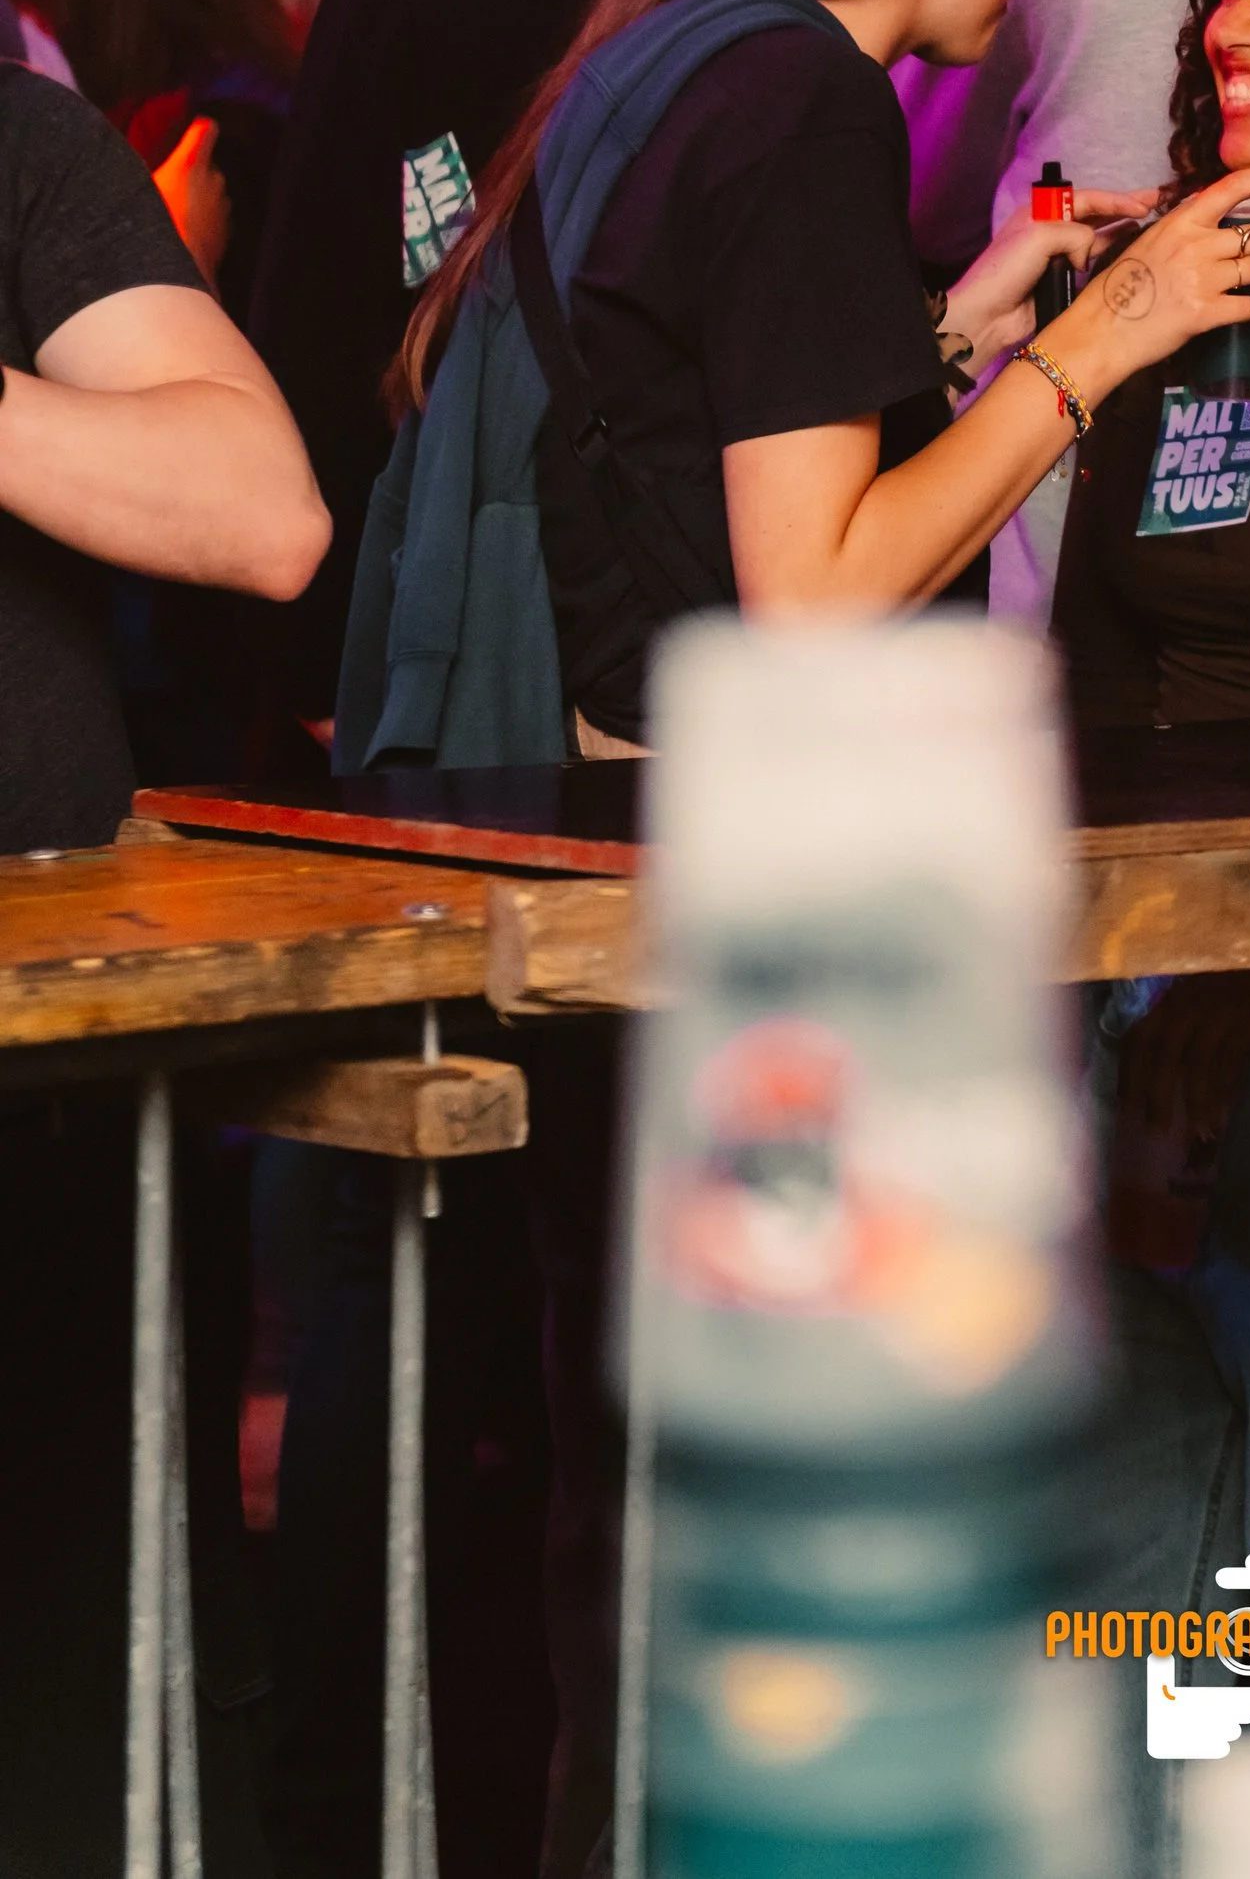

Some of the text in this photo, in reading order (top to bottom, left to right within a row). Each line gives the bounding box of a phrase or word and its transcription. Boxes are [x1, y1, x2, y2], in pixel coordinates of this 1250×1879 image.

[1112, 269, 1142, 310] +18
[1165, 400, 1235, 440] MAL
[1155, 436, 1228, 478] PER
[1152, 471, 1237, 514] TUUS
